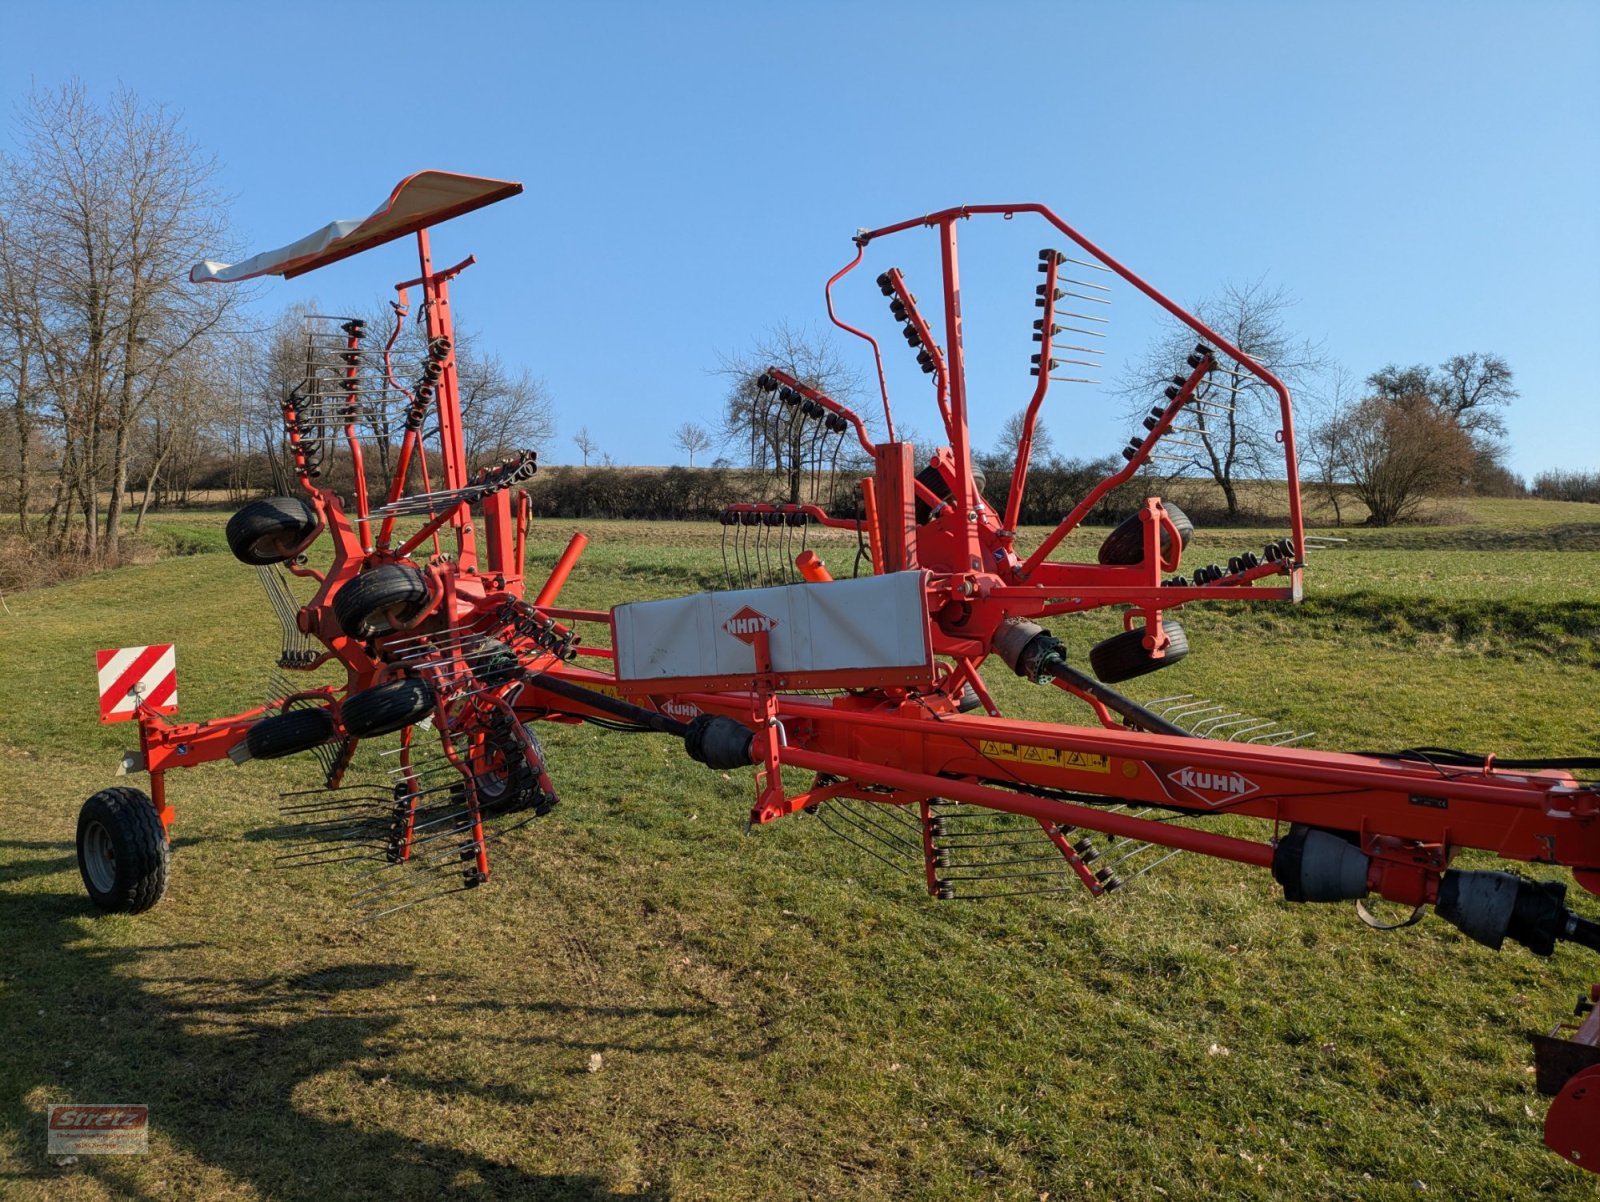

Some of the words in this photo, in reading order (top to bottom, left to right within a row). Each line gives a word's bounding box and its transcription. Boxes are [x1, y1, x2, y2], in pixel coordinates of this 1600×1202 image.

[727, 617, 771, 634] KUHN
[667, 702, 698, 717] KUHN
[1181, 770, 1245, 794] KUHN
